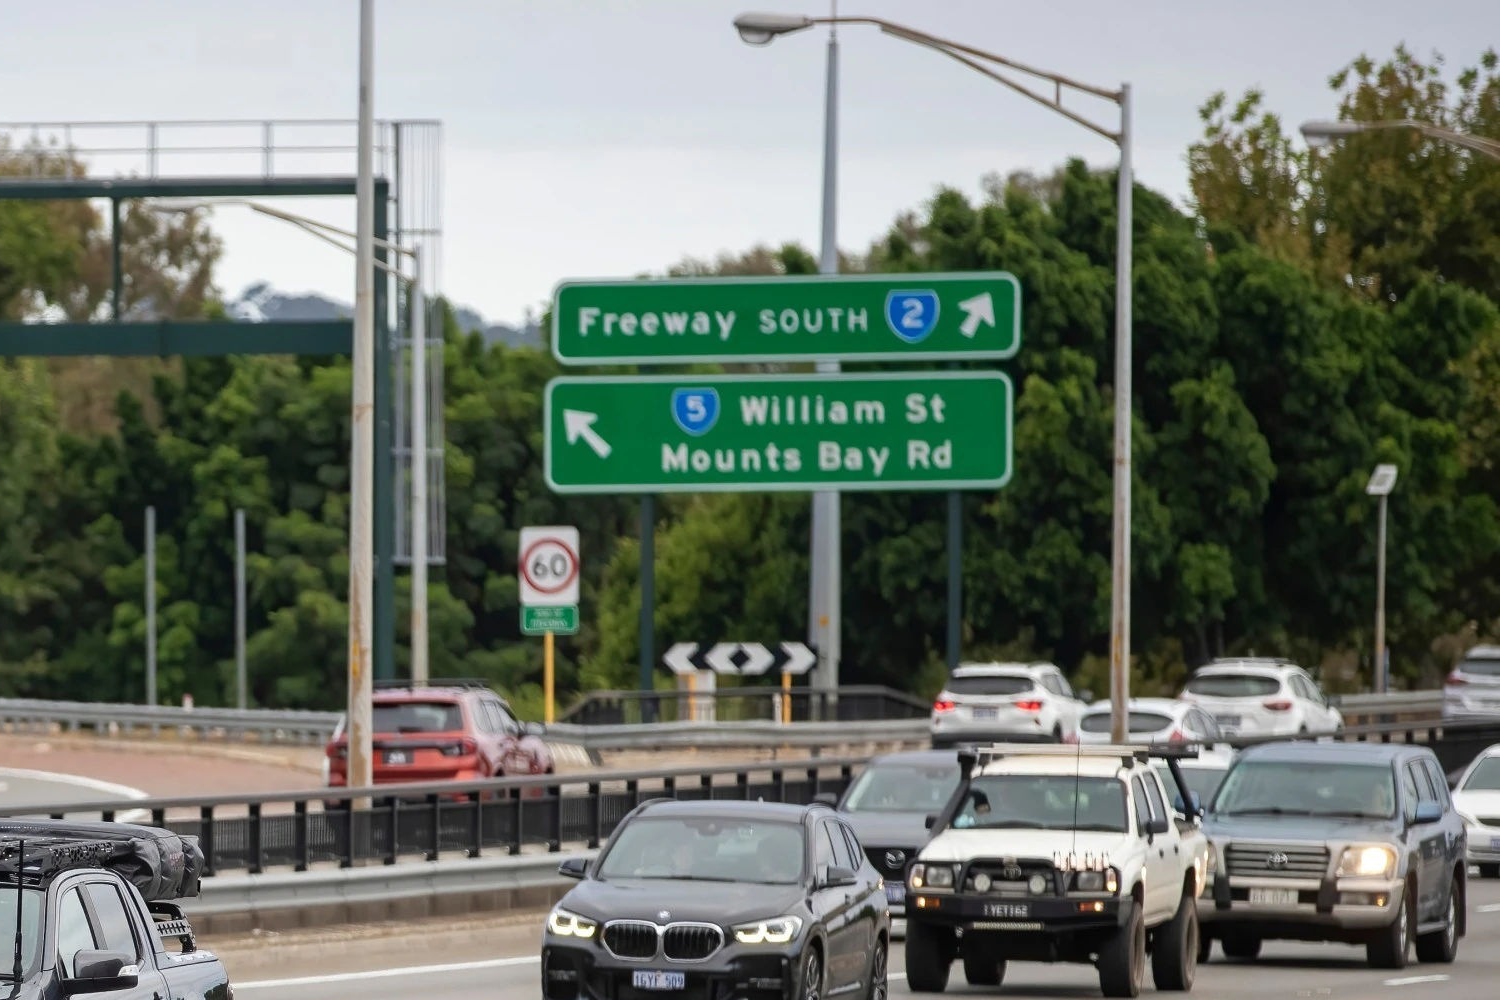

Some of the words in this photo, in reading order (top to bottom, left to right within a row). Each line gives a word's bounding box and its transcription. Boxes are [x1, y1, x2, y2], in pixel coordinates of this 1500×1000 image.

[578, 307, 736, 340] Freeway
[758, 307, 869, 334] SOUTH
[902, 298, 924, 329] 2
[686, 396, 706, 422] 5
[740, 396, 884, 425] William
[905, 394, 945, 423] St
[661, 443, 801, 474] Mounts
[819, 441, 890, 476] Bay
[907, 440, 952, 470] Rd
[533, 553, 567, 578] 60
